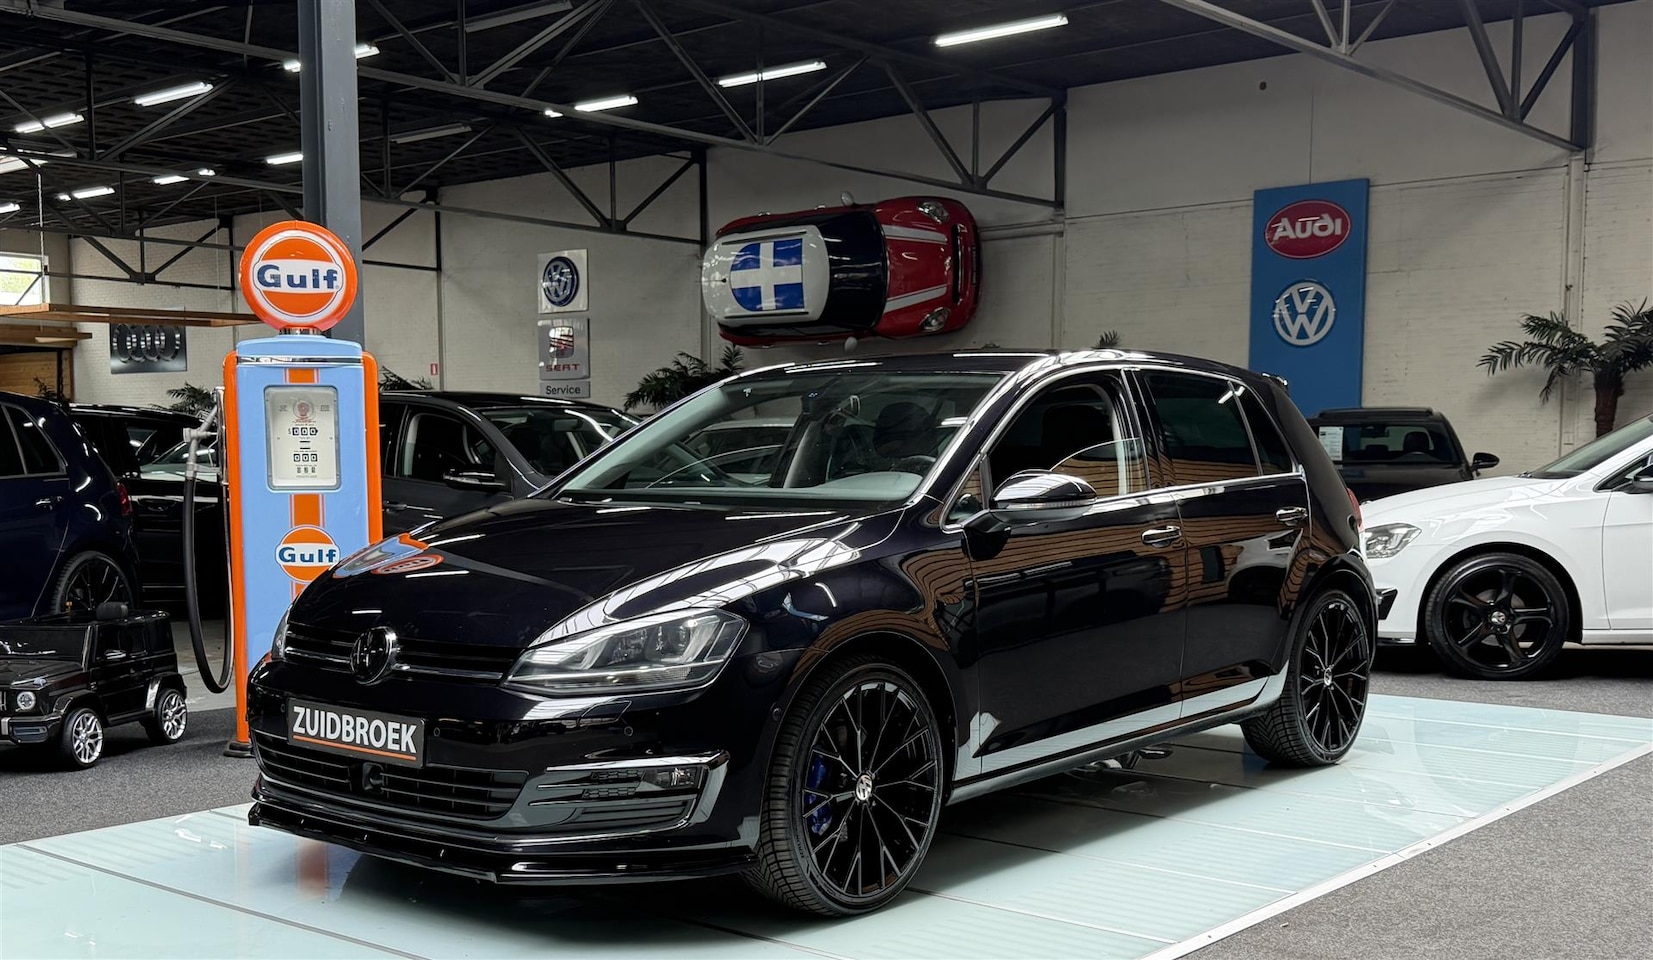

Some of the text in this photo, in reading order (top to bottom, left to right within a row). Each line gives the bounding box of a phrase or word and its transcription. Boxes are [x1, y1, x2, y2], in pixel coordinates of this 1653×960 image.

[1273, 213, 1342, 241] Audi
[257, 264, 338, 289] Gulf
[546, 363, 580, 372] SEAT
[545, 385, 581, 395] Service
[279, 547, 336, 563] Gulf
[293, 706, 417, 753] ZUIDBROEK
